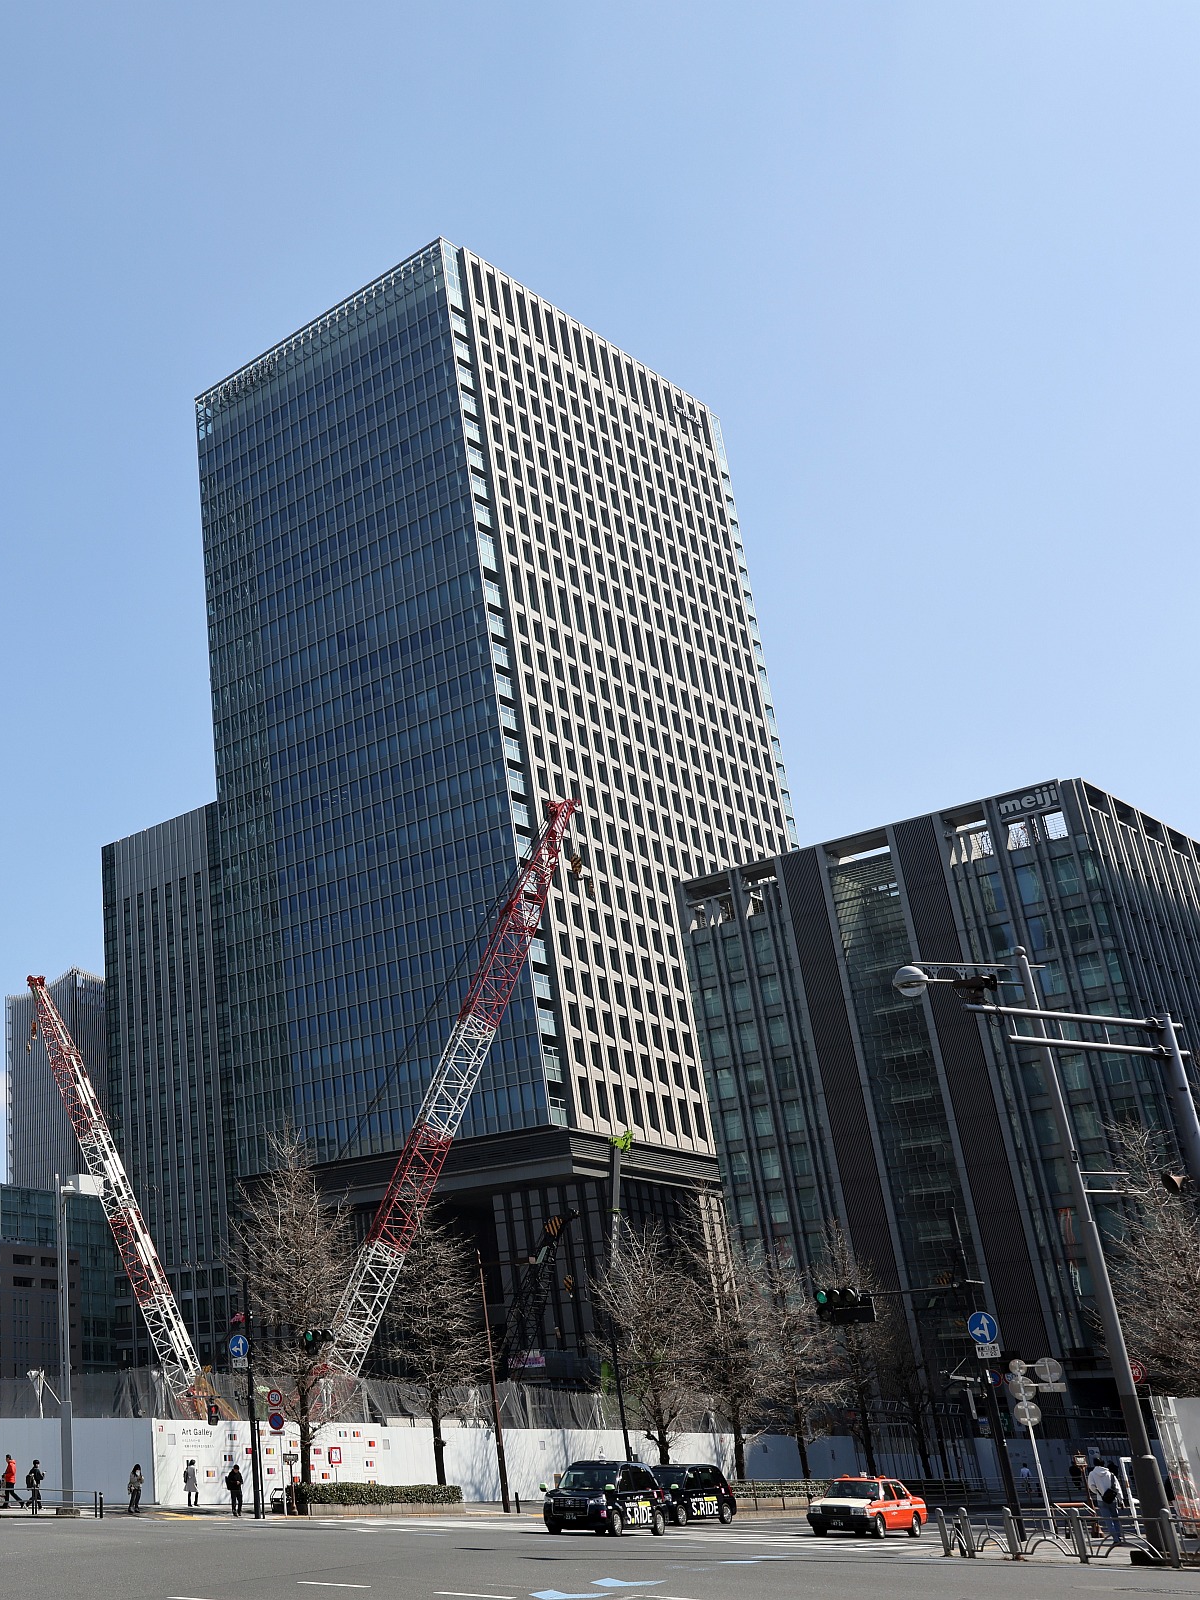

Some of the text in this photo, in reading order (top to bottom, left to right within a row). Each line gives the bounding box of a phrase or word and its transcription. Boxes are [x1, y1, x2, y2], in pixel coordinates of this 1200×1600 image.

[1000, 785, 1057, 814] meiji
[270, 1393, 280, 1402] 50
[181, 1428, 192, 1436] Art
[626, 1506, 653, 1524] S.RIDE
[691, 1500, 720, 1516] S.RIDE
